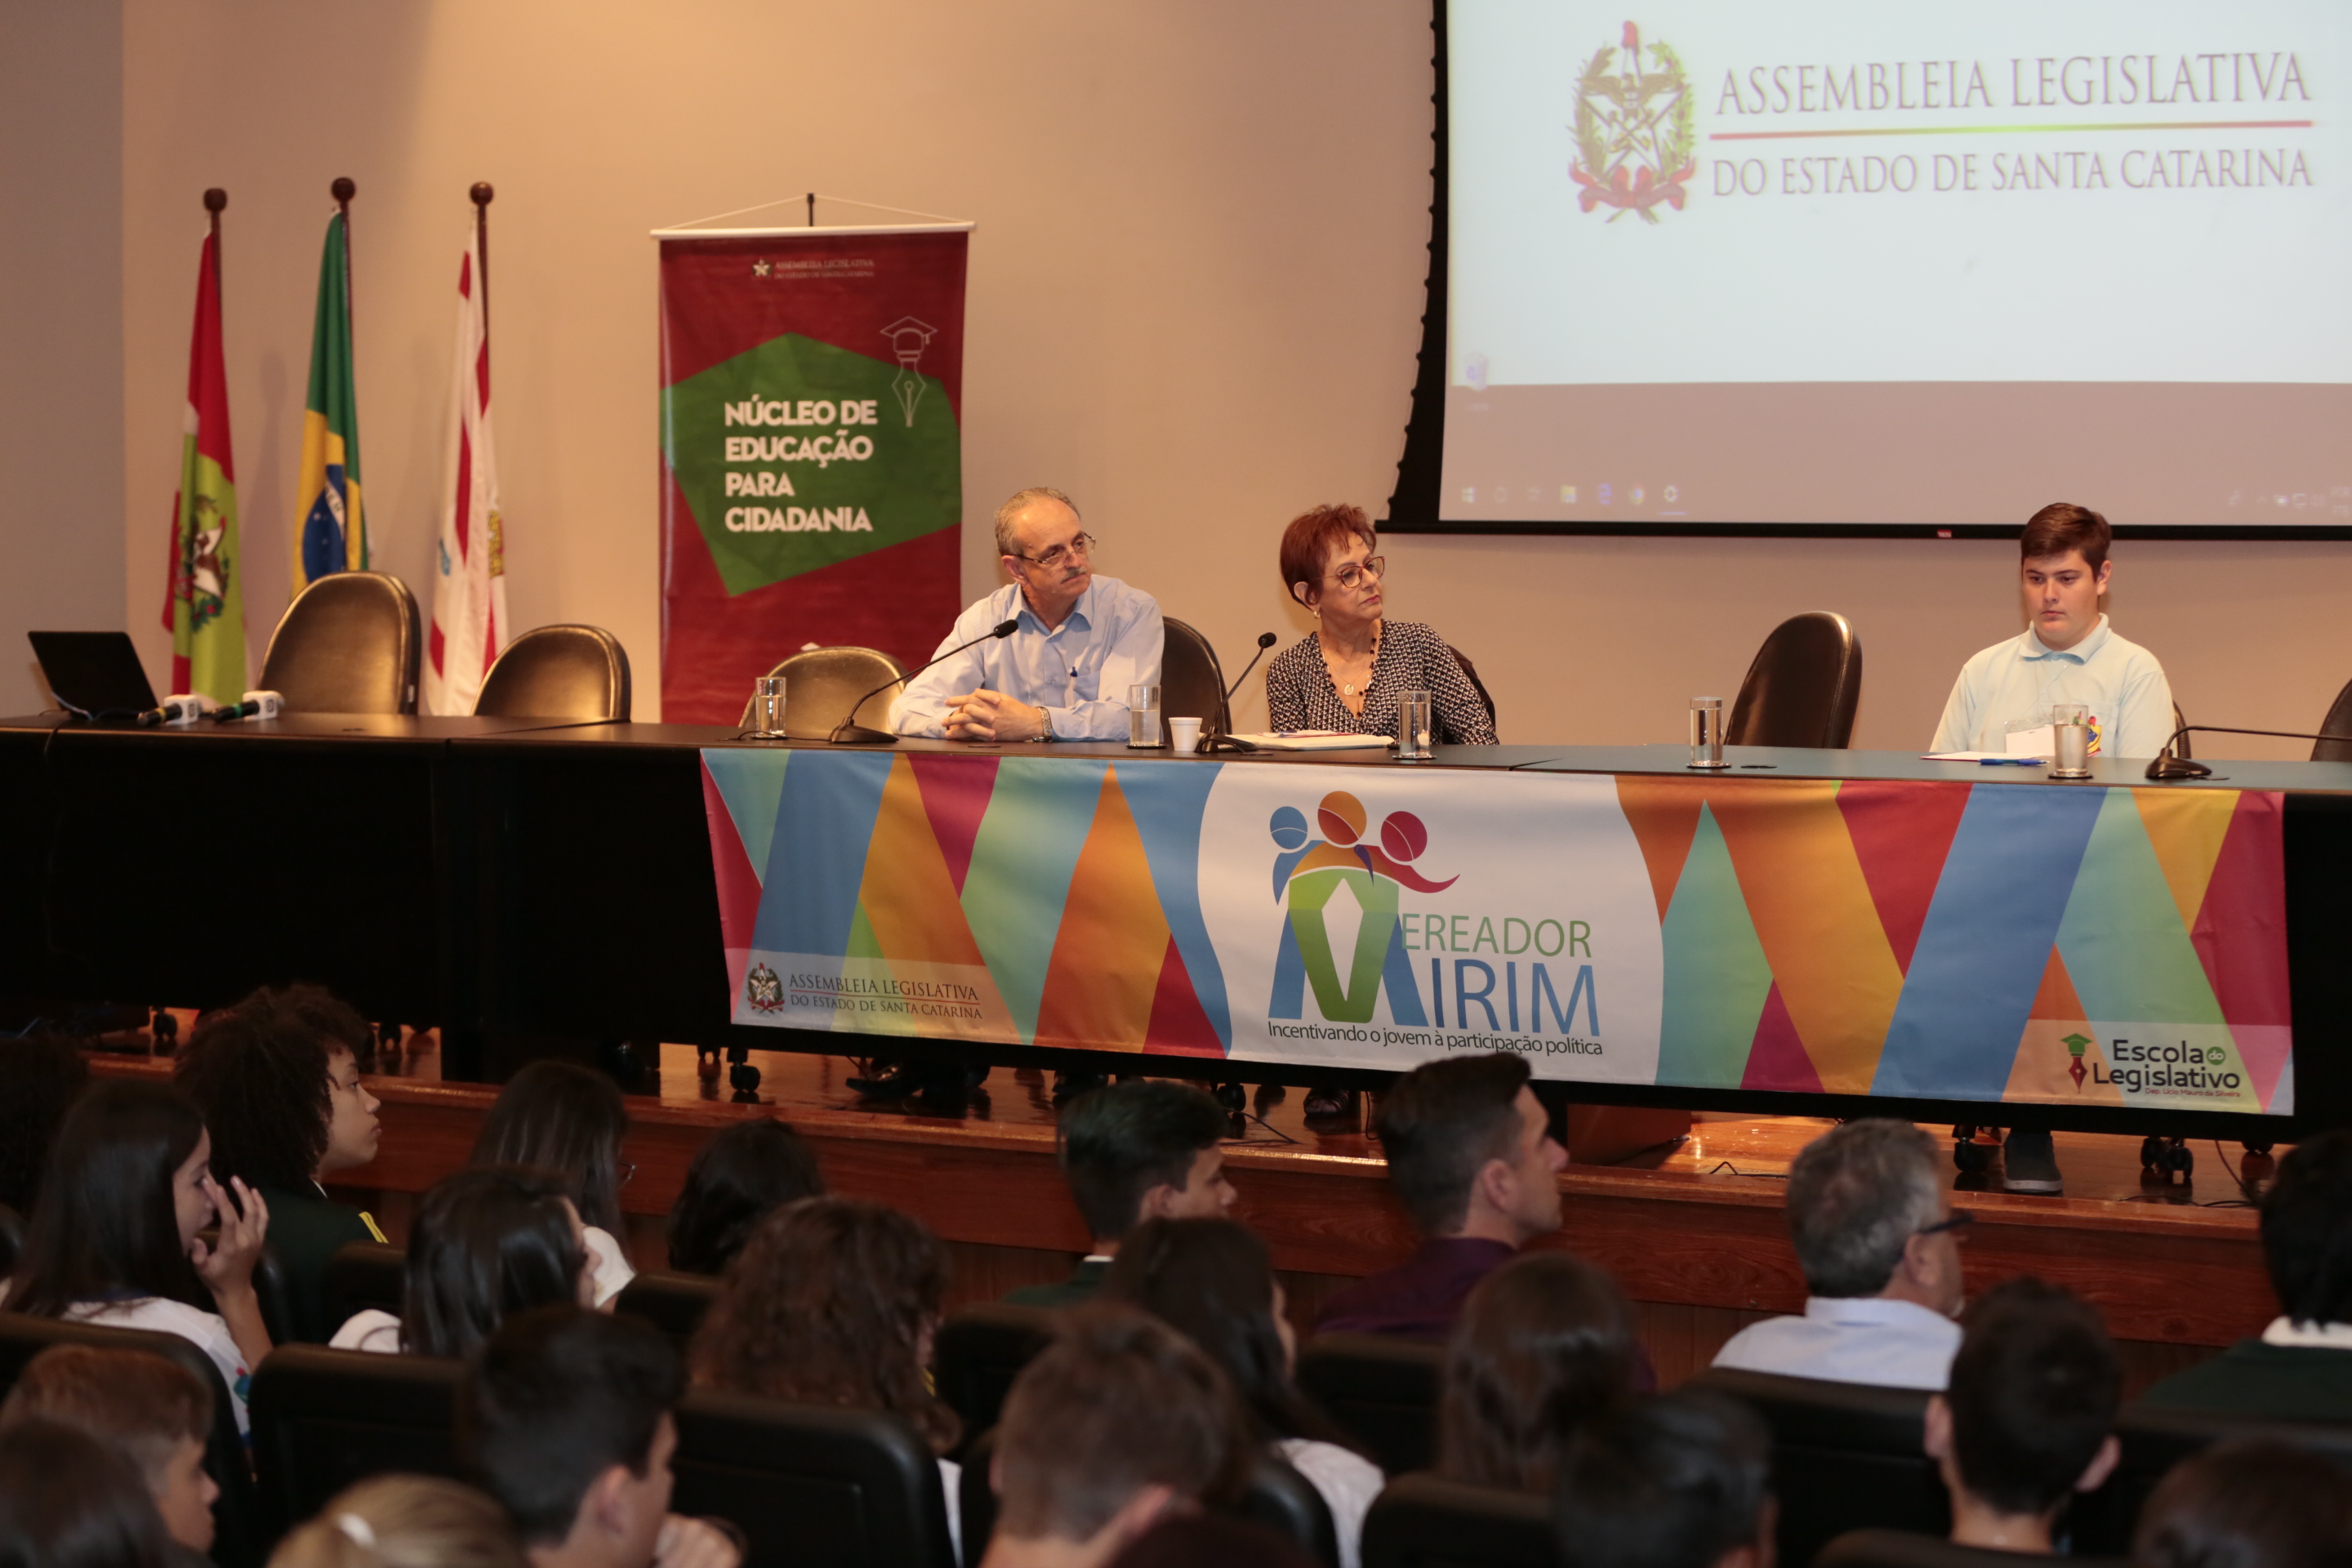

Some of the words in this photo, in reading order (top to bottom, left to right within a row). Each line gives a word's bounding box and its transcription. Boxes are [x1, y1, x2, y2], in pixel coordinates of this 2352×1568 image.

[1715, 60, 1993, 115] ASSEMBLEIA
[2010, 51, 2312, 106] LEGISLATIVA
[1713, 158, 1766, 196] DO
[1780, 154, 1918, 194] ESTADO
[1932, 154, 1979, 191] DE
[1991, 151, 2109, 190] SANTA
[2120, 149, 2314, 188] CATARINA
[724, 394, 836, 426] NÚCLEO
[840, 400, 878, 425] DE
[724, 430, 874, 468] EDUCAÇÃO
[724, 472, 795, 497] PARA
[724, 506, 873, 532] CIDADANIA
[789, 973, 880, 994] ASSEMBLEIA
[883, 980, 978, 1001] LEGISLATIVA
[791, 994, 808, 1006] DO
[813, 996, 855, 1011] ESTADO
[859, 1000, 876, 1012] DE
[880, 1000, 918, 1014] SANTA
[921, 1004, 982, 1019] CATARINA
[1268, 1021, 1367, 1042] Incentivando
[1370, 1030, 1381, 1042] o
[1383, 1027, 1432, 1047] jovem
[1435, 1030, 1444, 1046] à
[1446, 1032, 1543, 1054] participação
[1546, 1037, 1603, 1057] política
[2113, 1039, 2204, 1064] Escola
[2208, 1049, 2225, 1061] do
[2093, 1062, 2241, 1093] Legislativo
